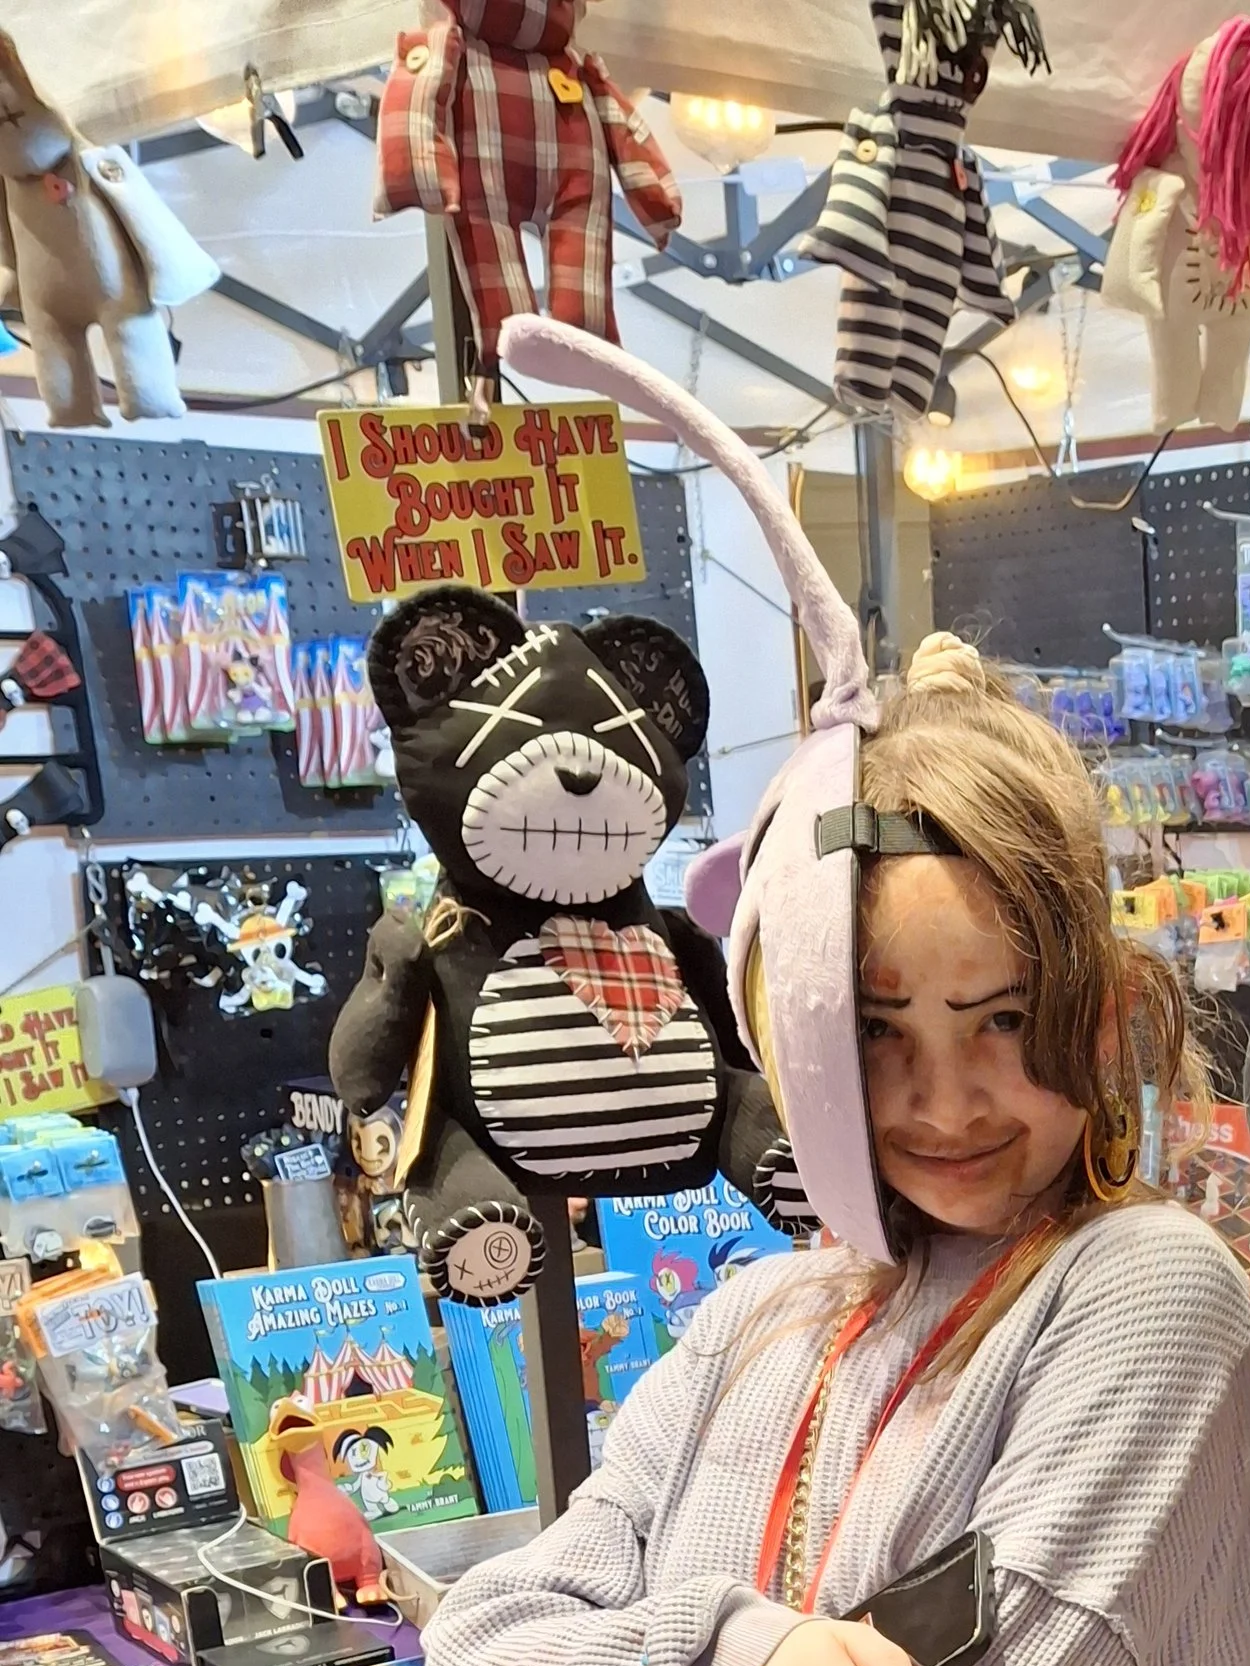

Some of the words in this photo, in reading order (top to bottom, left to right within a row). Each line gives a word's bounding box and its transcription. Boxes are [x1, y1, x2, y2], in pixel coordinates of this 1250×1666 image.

[327, 419, 349, 480] I
[514, 409, 619, 466] HAVE
[387, 472, 534, 537] BOUGHT
[545, 464, 579, 524] IT
[346, 526, 464, 593] WHEN
[472, 529, 492, 587] I
[501, 522, 580, 584] SAW
[592, 520, 638, 578] IT.
[290, 1091, 344, 1135] BENDY
[644, 1210, 700, 1240] COLOR
[703, 1208, 753, 1239] BOOK
[251, 1283, 309, 1312] KARMA
[310, 1276, 360, 1304] DOLL
[577, 1295, 600, 1311] LOR
[603, 1290, 637, 1311] BOOK
[247, 1308, 322, 1341] AMAZING
[324, 1300, 377, 1326] MAZES
[480, 1307, 521, 1328] KARMA
[406, 1499, 433, 1512] TAMMY
